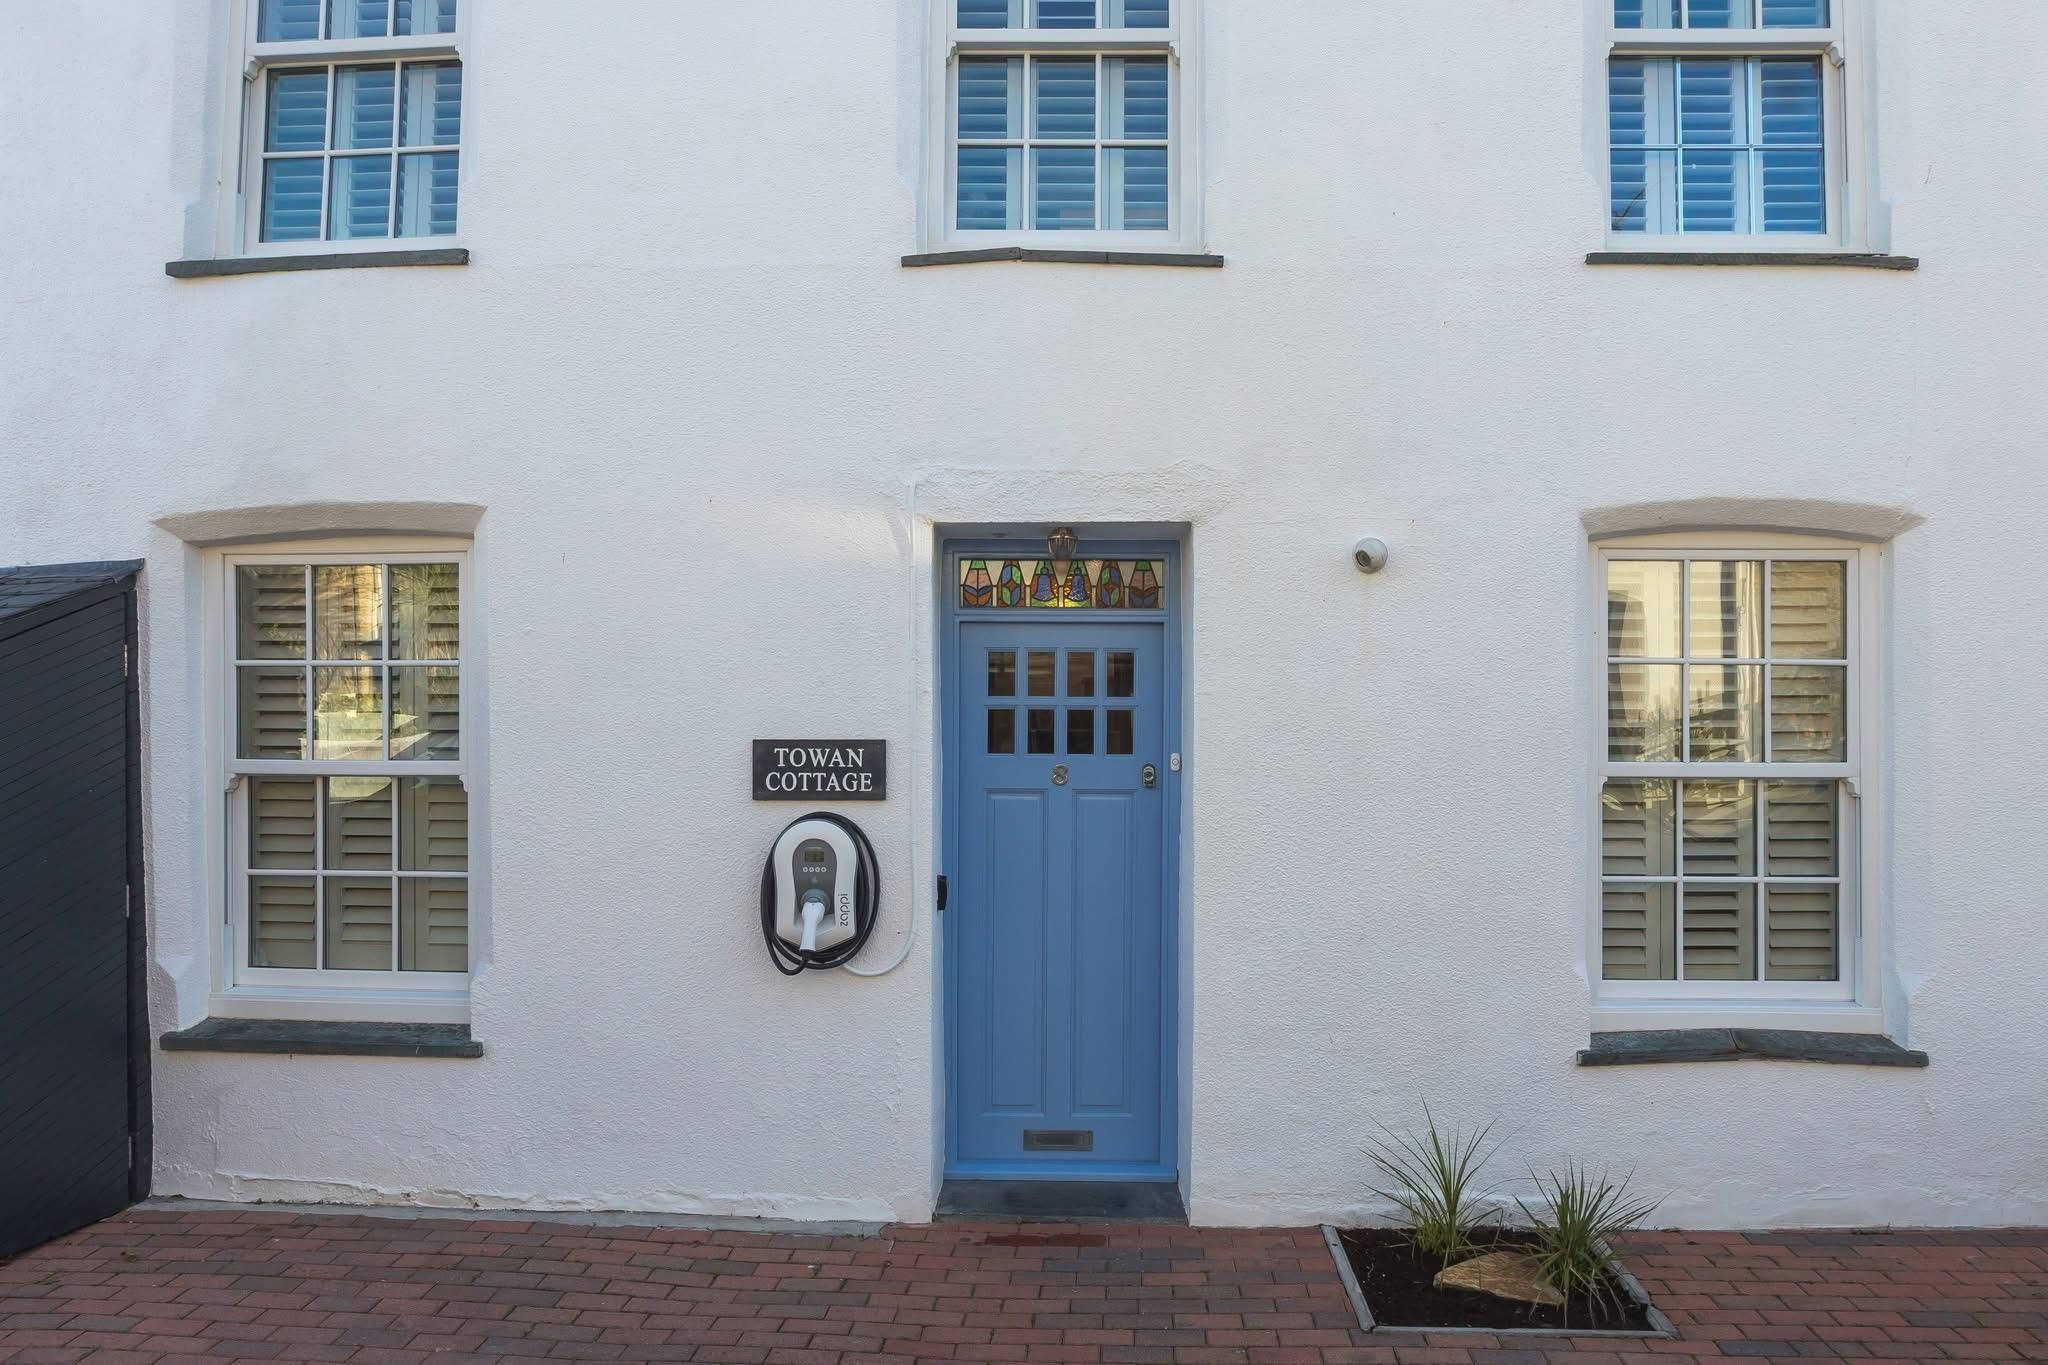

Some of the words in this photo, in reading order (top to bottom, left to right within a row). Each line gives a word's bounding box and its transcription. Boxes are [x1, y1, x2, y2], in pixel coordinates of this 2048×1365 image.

[774, 748, 864, 767] TOWAN
[765, 772, 872, 791] COTTAGE
[838, 893, 850, 926] zappi
